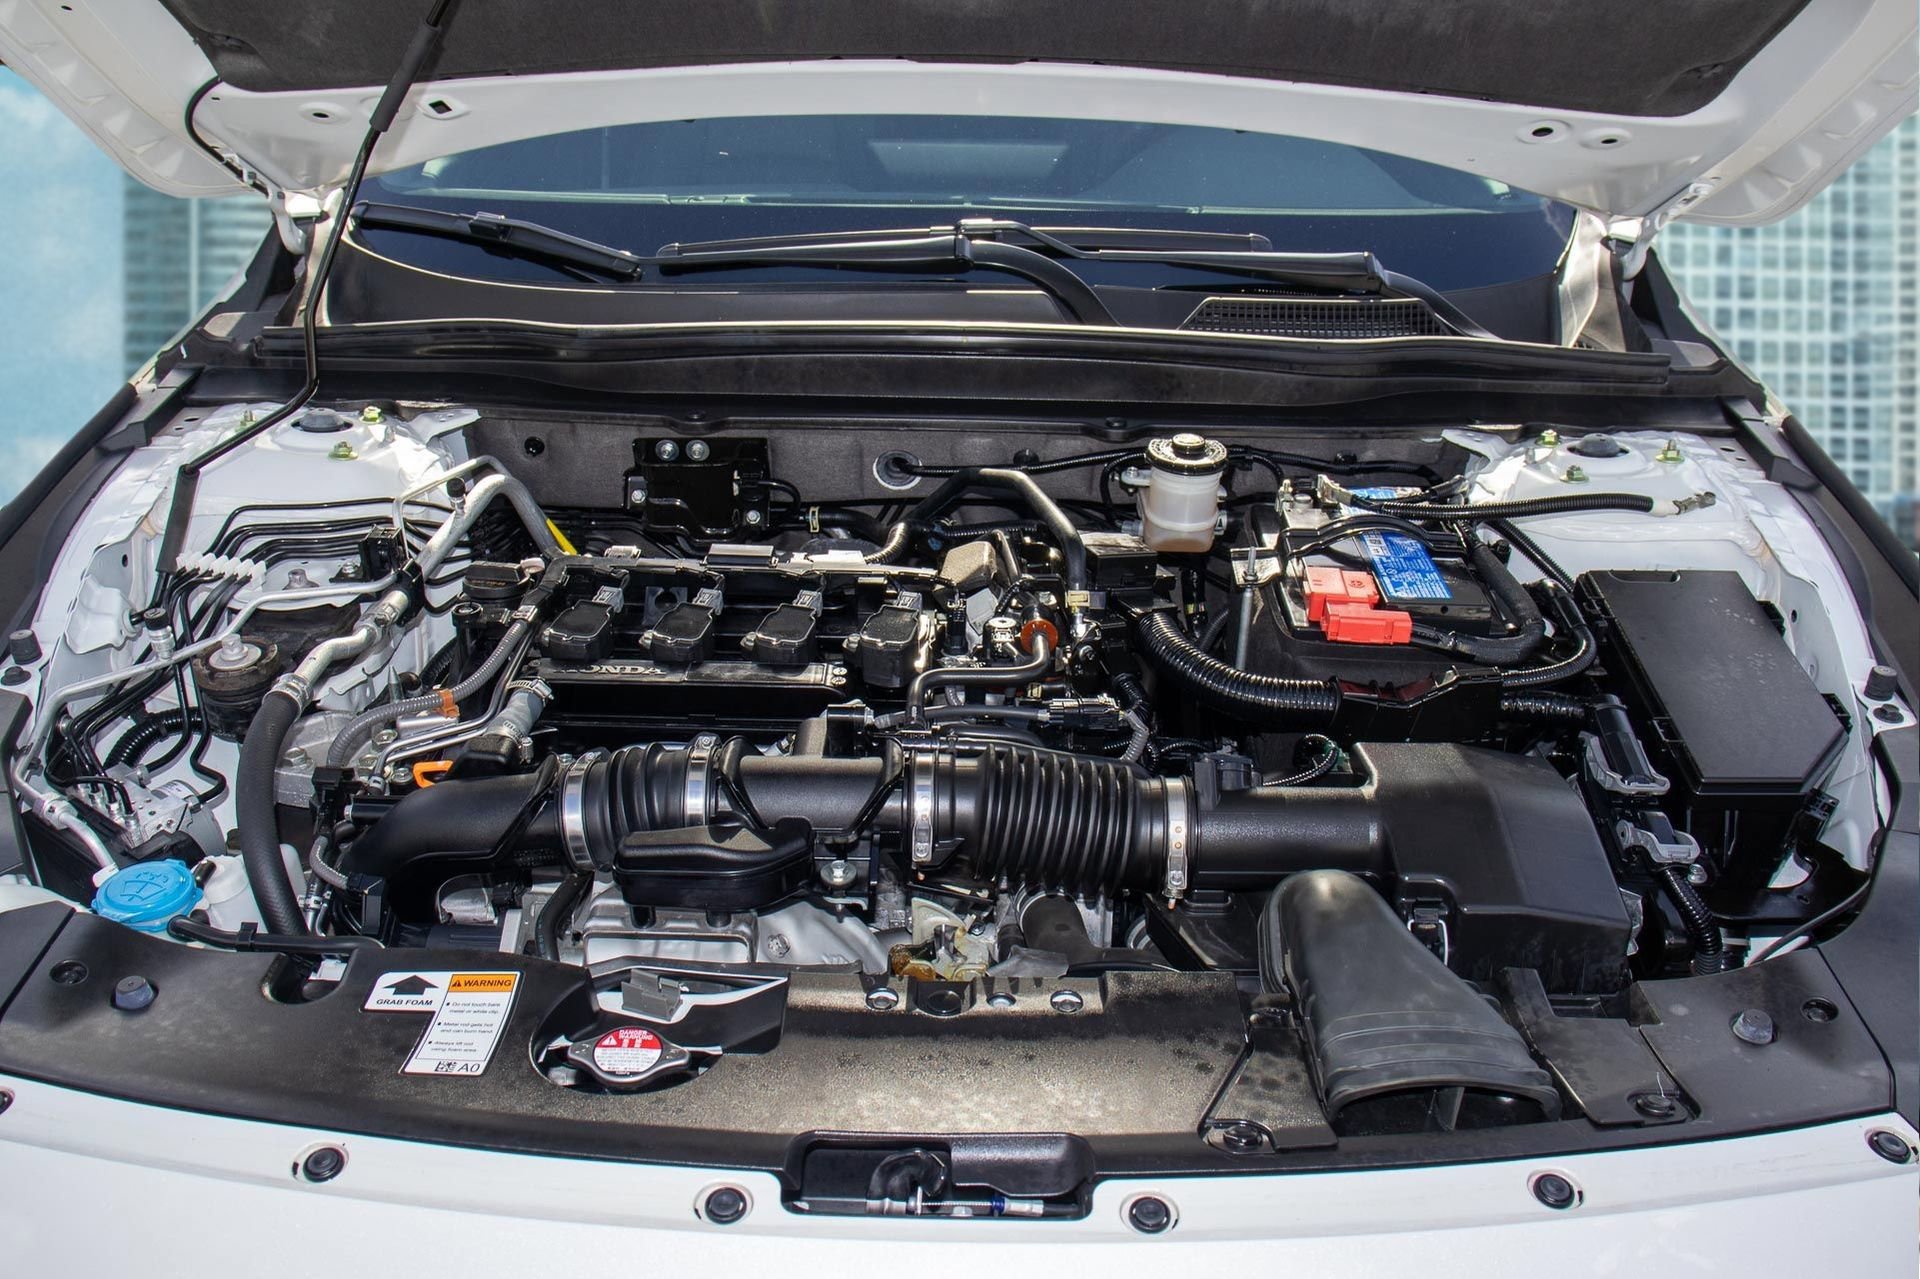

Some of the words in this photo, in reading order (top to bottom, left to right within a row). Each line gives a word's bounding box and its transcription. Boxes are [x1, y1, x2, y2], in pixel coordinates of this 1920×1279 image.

[553, 664, 667, 675] ONDA
[464, 979, 512, 987] WARNING
[457, 1063, 480, 1072] A0
